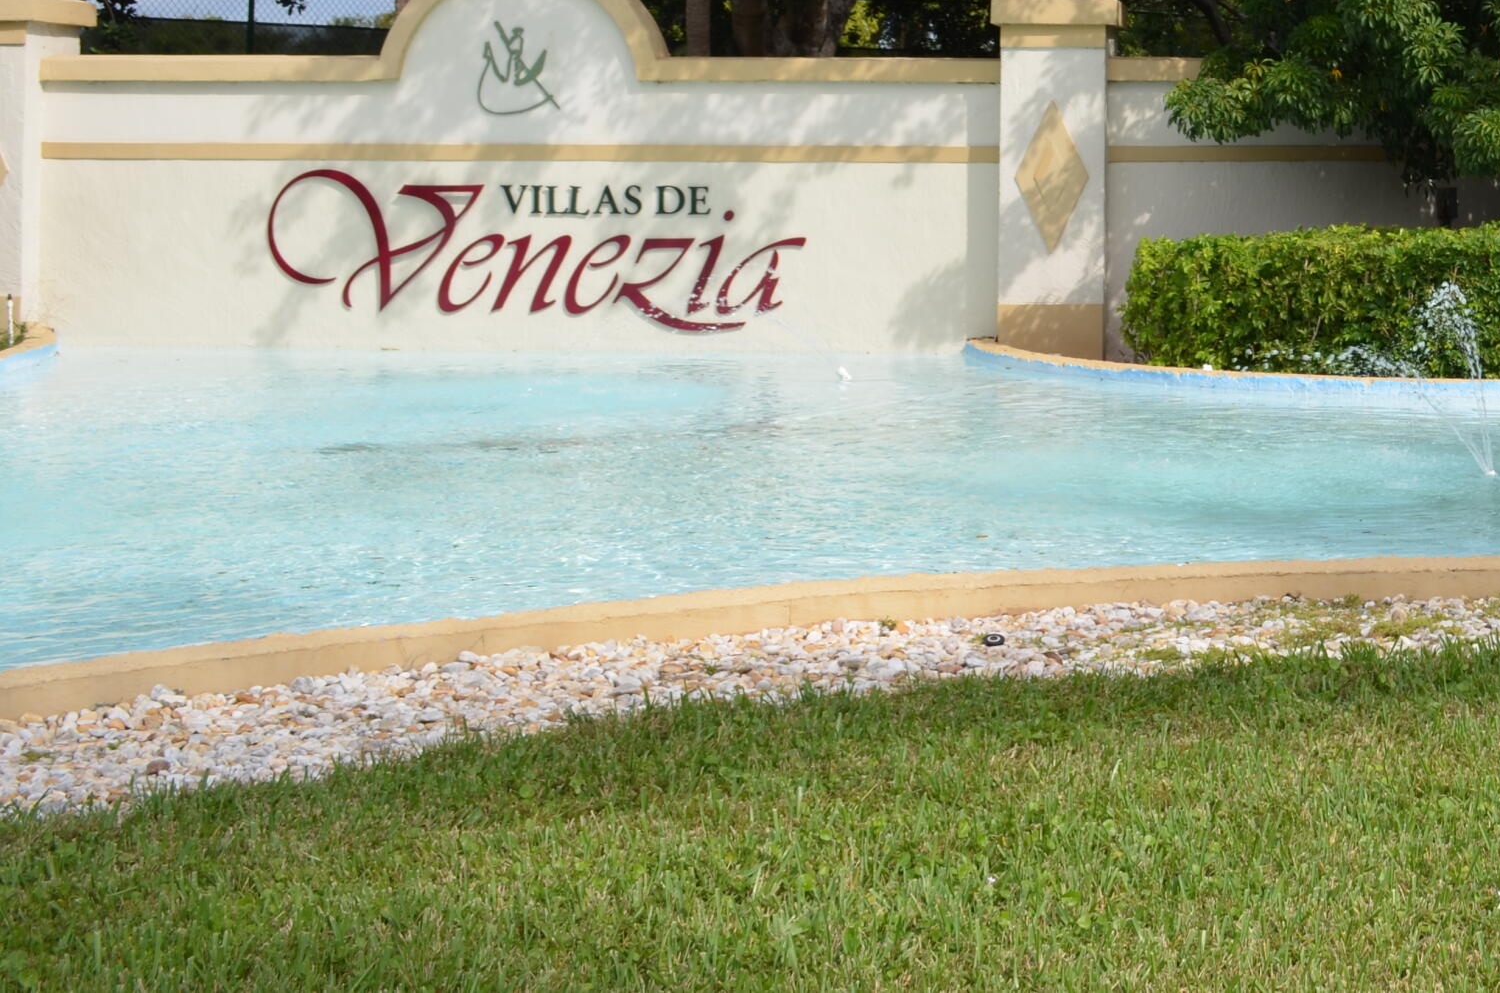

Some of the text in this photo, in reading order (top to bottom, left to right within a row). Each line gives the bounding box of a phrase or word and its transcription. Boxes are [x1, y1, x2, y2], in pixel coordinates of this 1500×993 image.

[500, 184, 711, 216] VILLAS DE
[267, 169, 806, 332] Venezia
